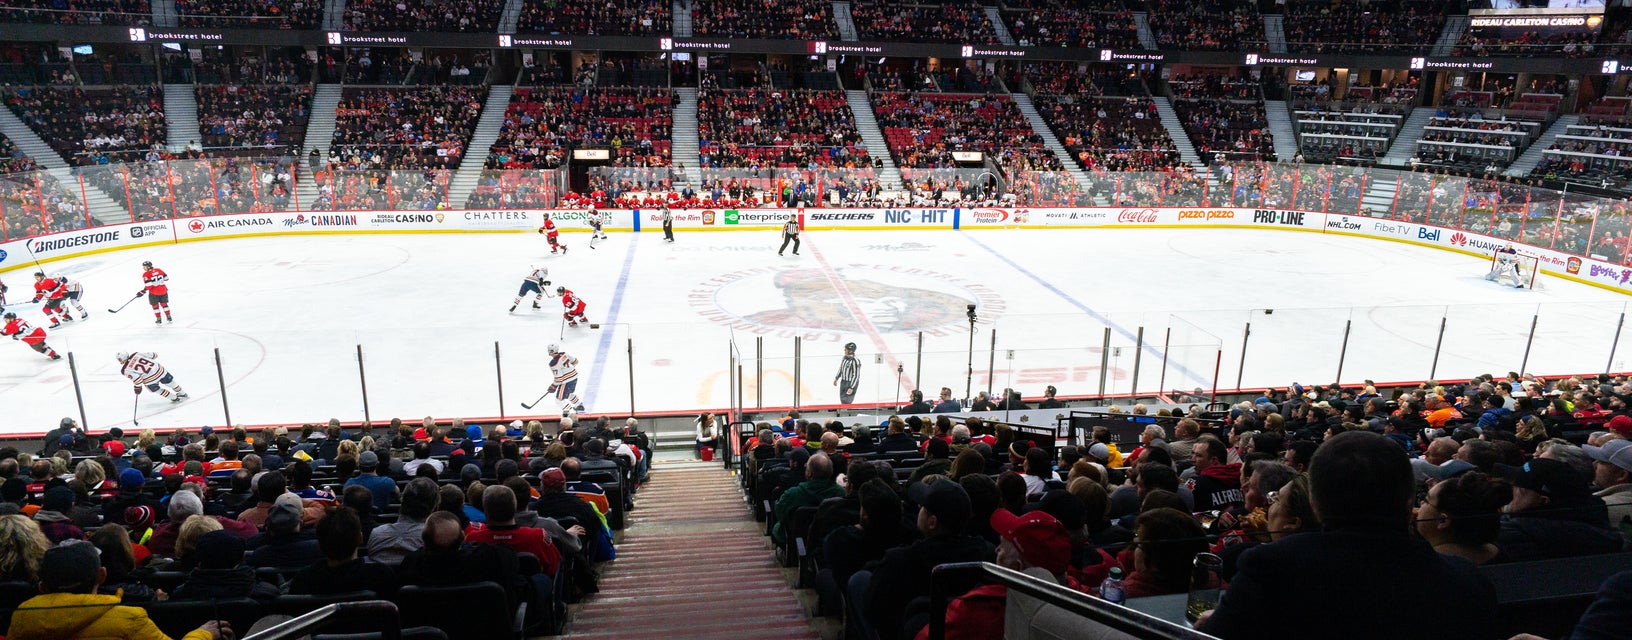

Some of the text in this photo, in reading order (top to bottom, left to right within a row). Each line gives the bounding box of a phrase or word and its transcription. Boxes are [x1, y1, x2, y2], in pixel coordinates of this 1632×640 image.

[464, 212, 526, 220] CHATTERS
[729, 213, 790, 222] enterprise
[921, 210, 948, 223] HIT
[973, 210, 1000, 218] Premier
[1178, 210, 1234, 220] pizza pizza
[207, 218, 273, 229] AIR CANADA
[311, 215, 358, 226] CANADIAN
[1327, 222, 1362, 230] NHL.COM
[1374, 222, 1410, 234] Fibe TV
[1418, 227, 1440, 241] Bell
[34, 230, 120, 253] BRIDGESTONE
[1469, 238, 1502, 252] HUAWE
[1540, 255, 1565, 266] the Rim
[1590, 264, 1620, 280] Booster
[134, 358, 154, 374] 29
